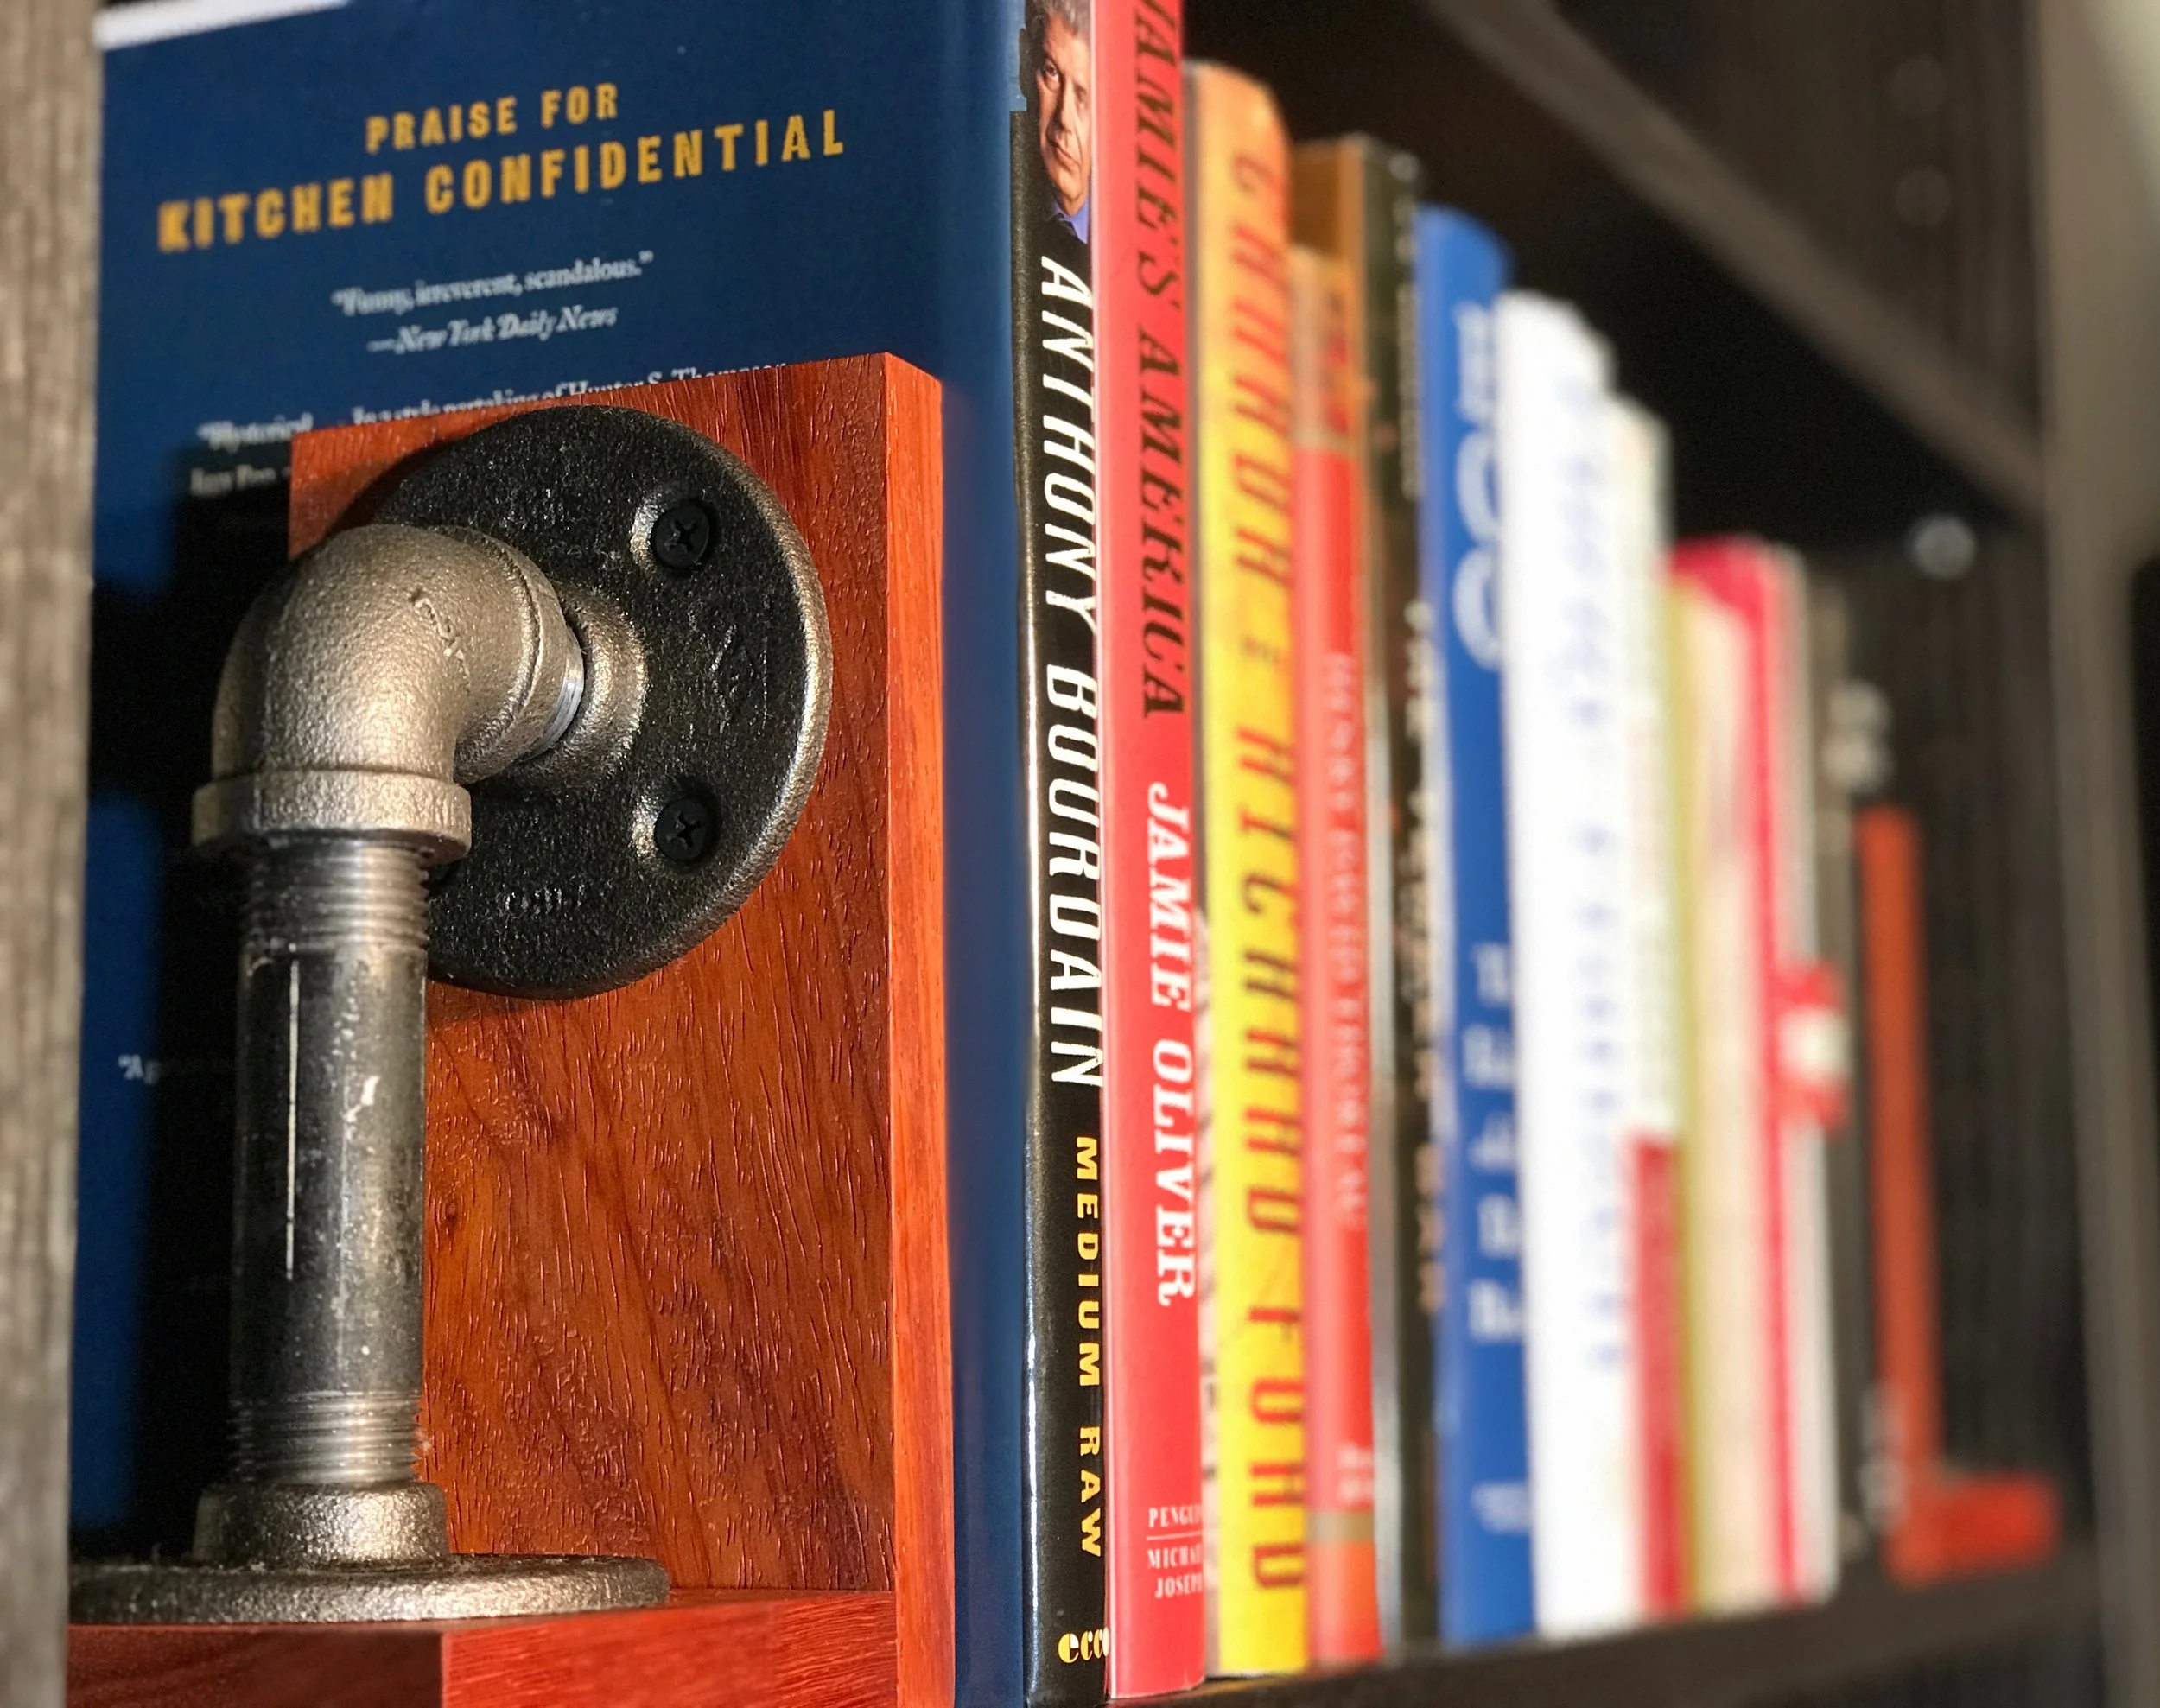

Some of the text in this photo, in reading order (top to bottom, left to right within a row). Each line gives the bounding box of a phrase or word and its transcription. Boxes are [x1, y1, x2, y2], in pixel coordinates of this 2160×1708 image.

[157, 110, 843, 254] KITCHEN CONFIDENTIAL
[365, 83, 617, 155] PRAISE FOR
[496, 309, 557, 342] Daily
[556, 304, 619, 333] News
[1139, 323, 1186, 718] AMERICA
[1041, 256, 1103, 1088] ANTHONY BOURDAIN
[1147, 781, 1198, 1307] JAMIE OLIVER
[1076, 1136, 1102, 1558] MEDIUM RAW
[1058, 1627, 1110, 1664] ecco
